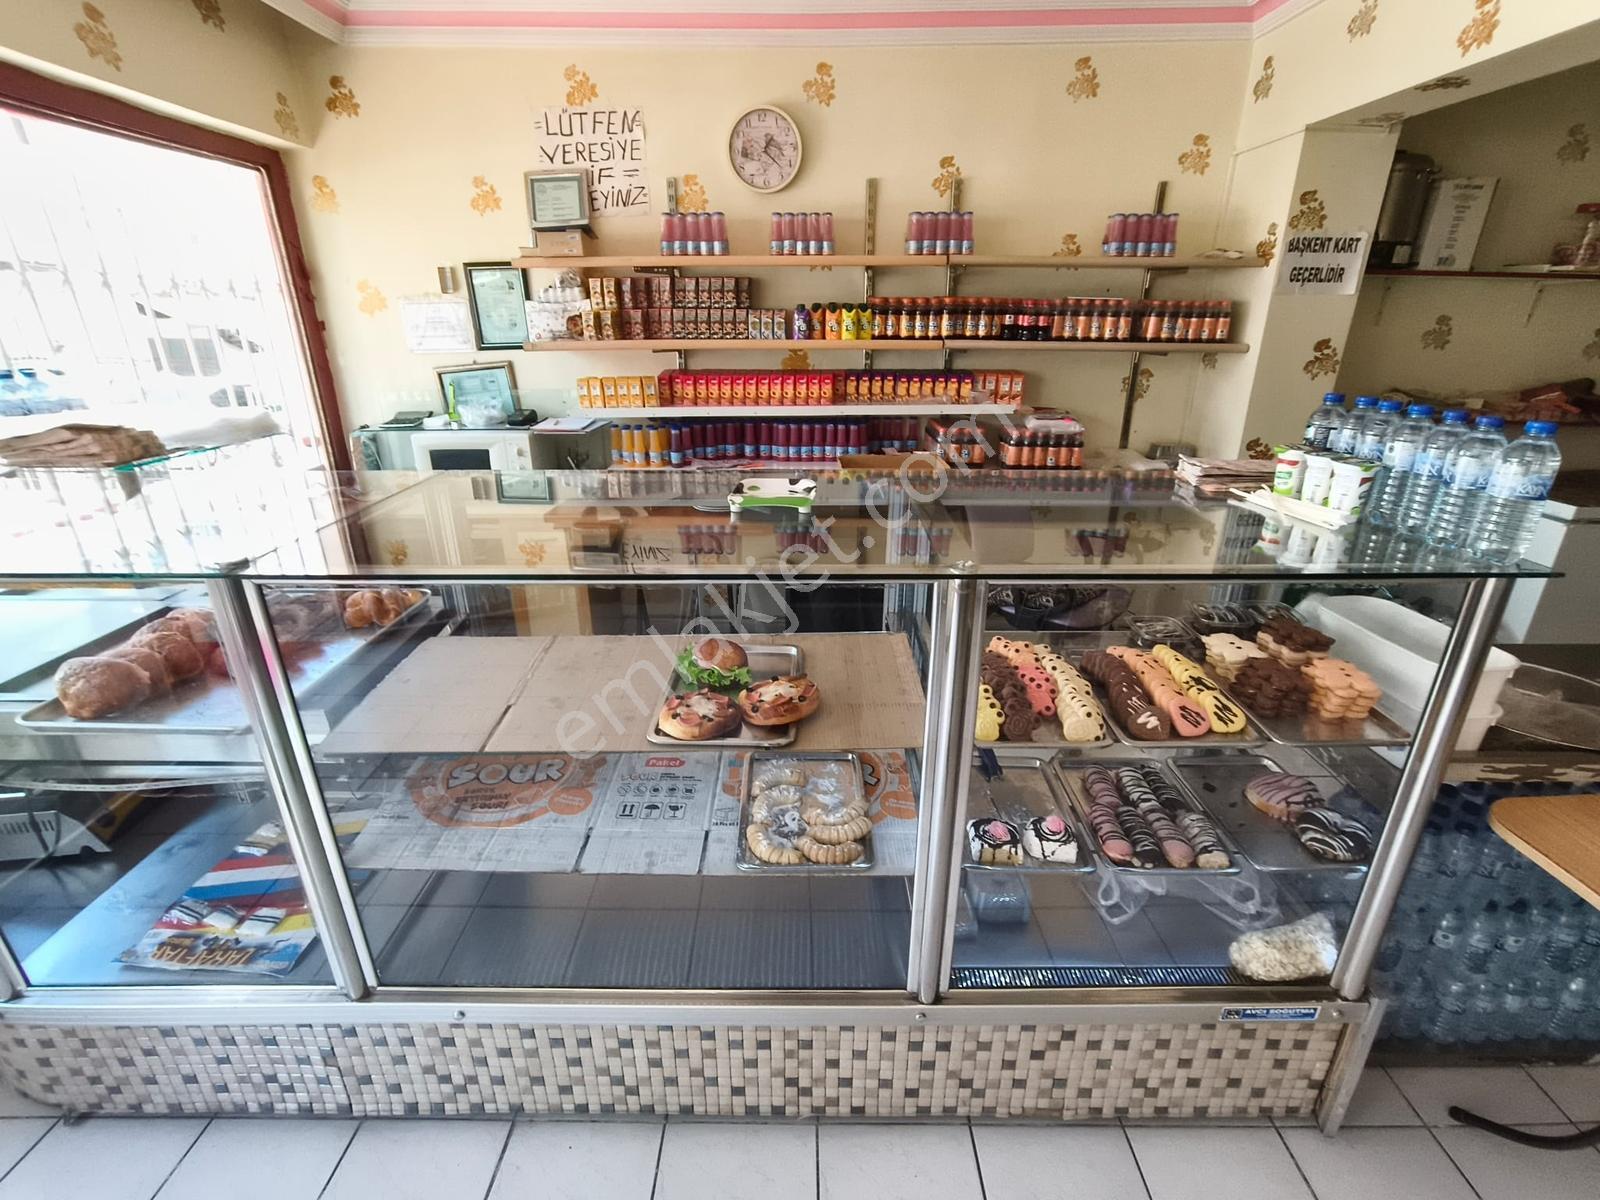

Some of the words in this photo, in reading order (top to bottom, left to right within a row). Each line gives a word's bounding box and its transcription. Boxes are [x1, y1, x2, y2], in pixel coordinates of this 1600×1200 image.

[1287, 237, 1334, 257] BAŞKENT
[1334, 237, 1361, 253] KART
[1289, 264, 1344, 287] GEÇERLİDİR
[448, 758, 566, 789] SOUR
